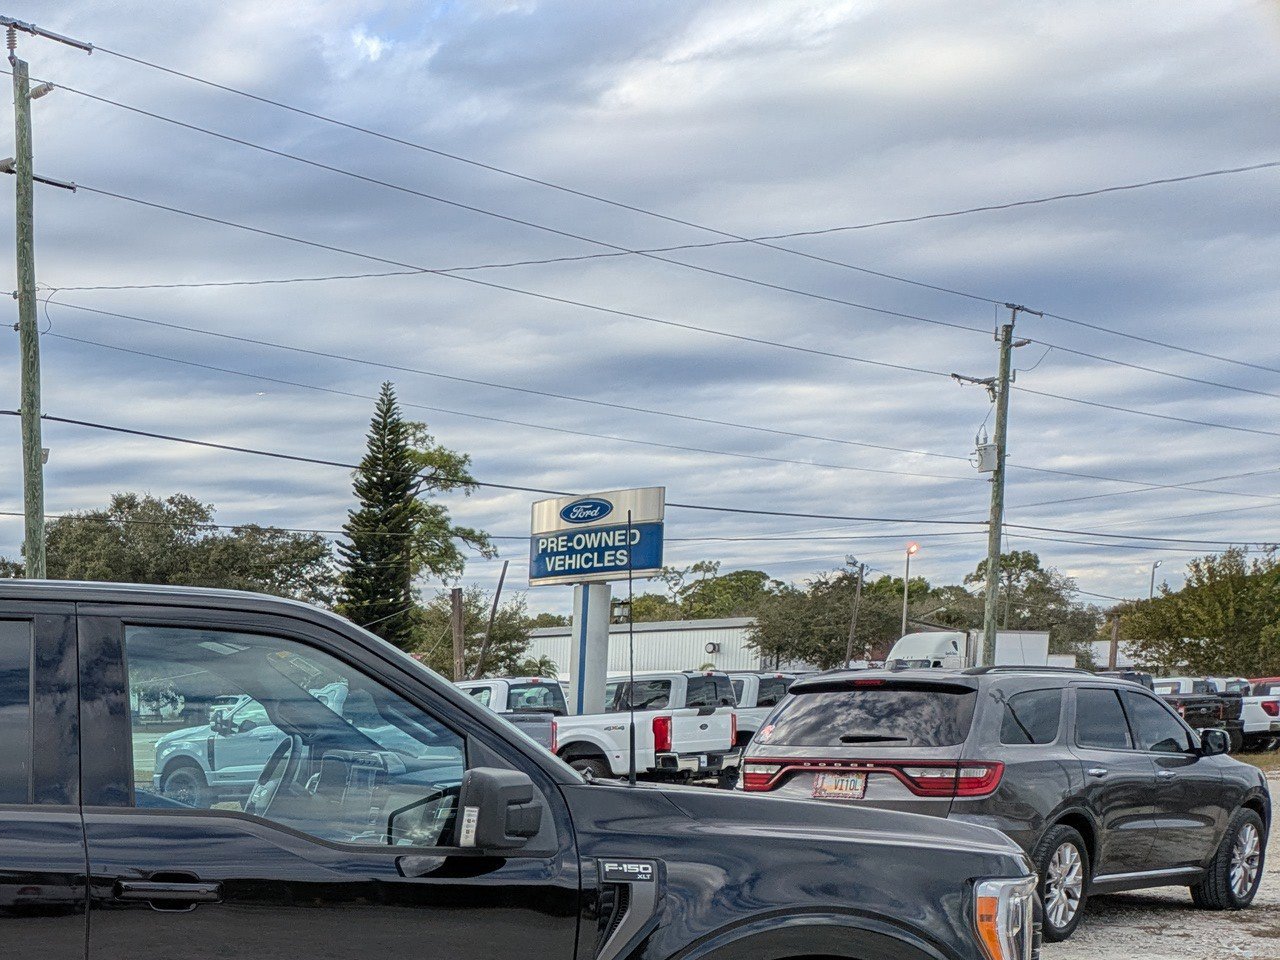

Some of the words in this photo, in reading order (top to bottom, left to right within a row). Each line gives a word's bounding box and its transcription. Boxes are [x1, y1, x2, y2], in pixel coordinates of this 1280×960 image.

[569, 504, 601, 519] Ford
[538, 529, 640, 554] PRE-OWNED
[545, 550, 628, 572] VEHICLES
[604, 863, 652, 873] F-150
